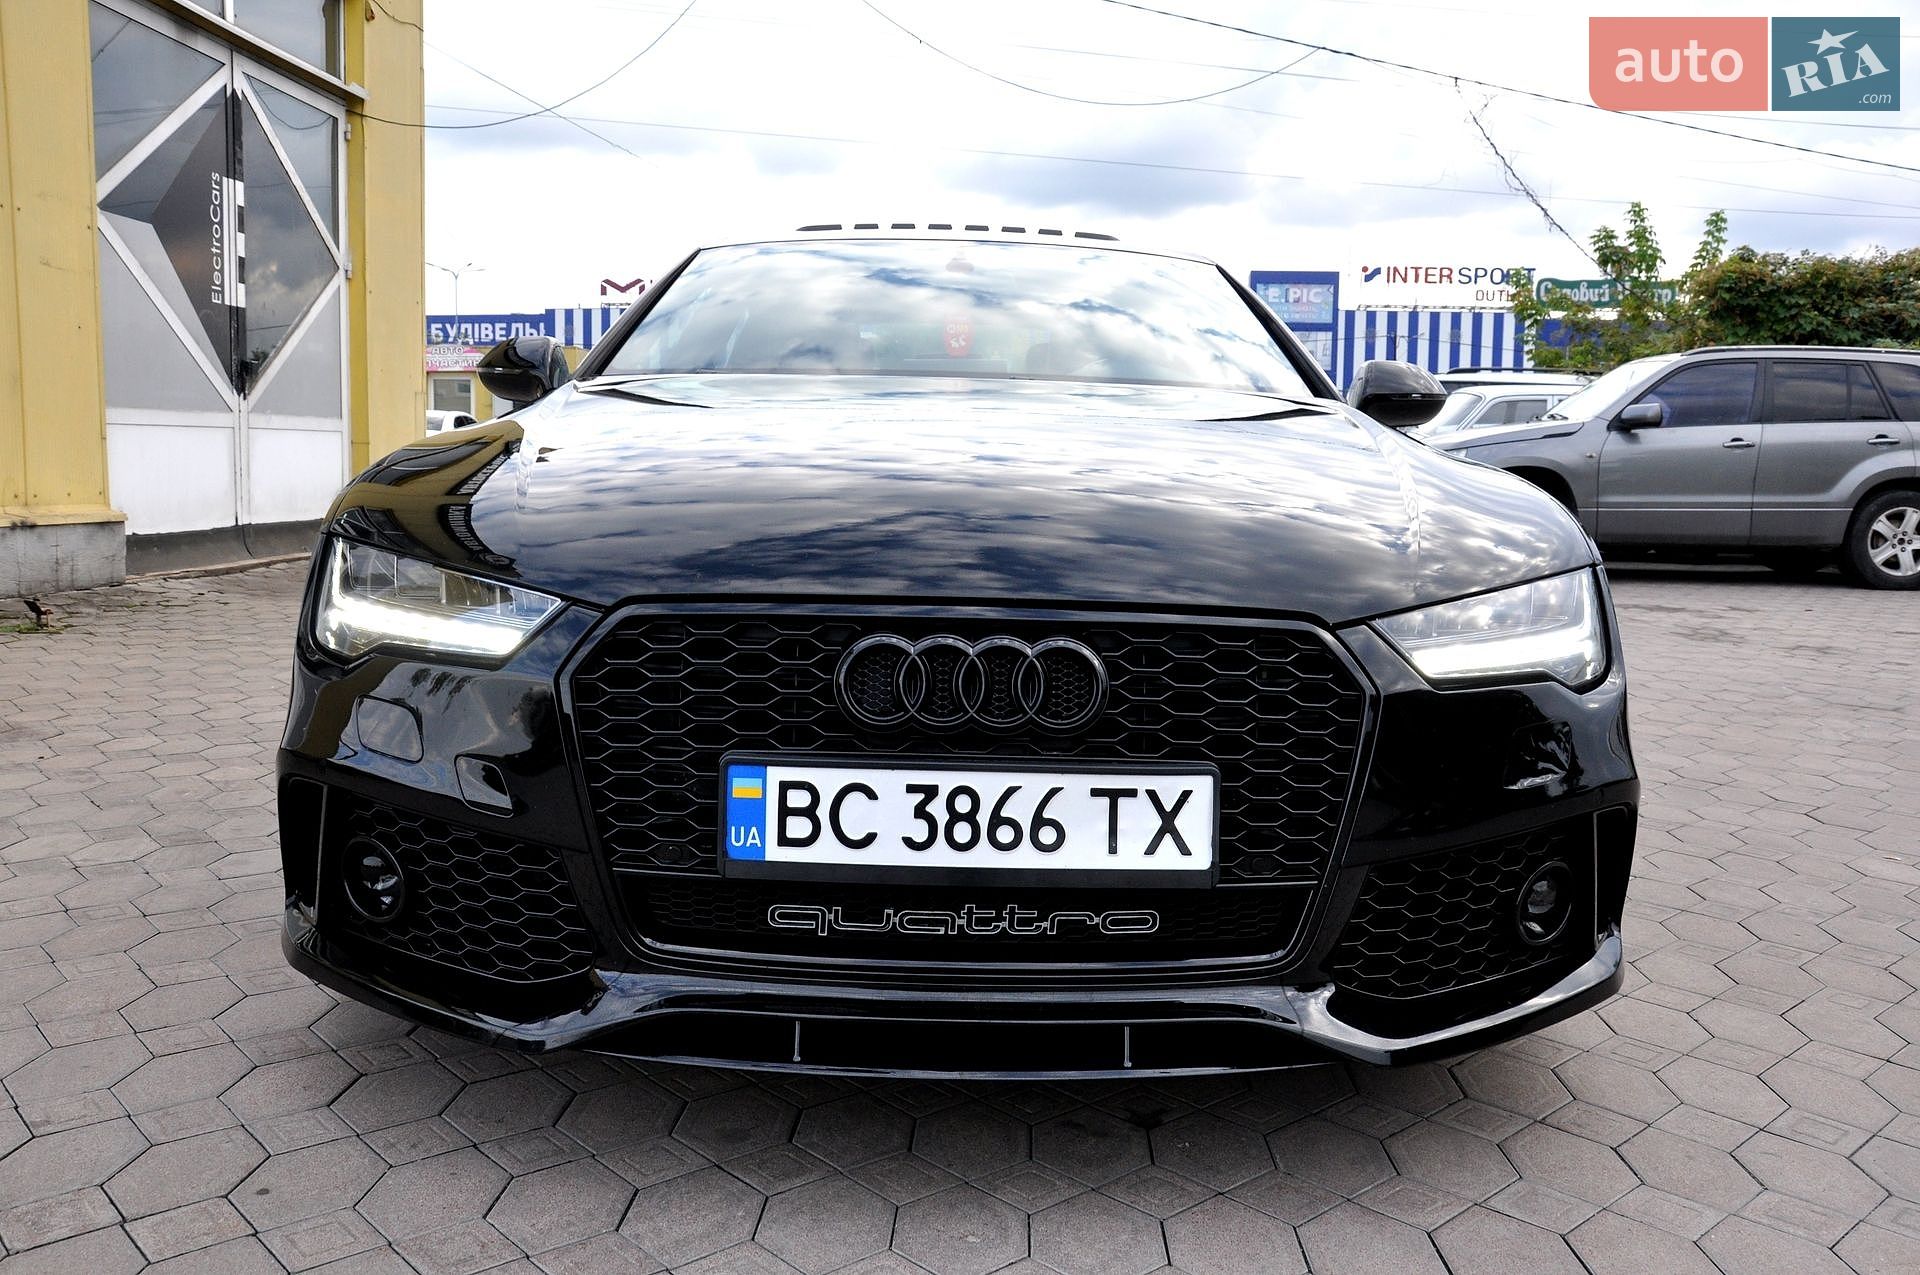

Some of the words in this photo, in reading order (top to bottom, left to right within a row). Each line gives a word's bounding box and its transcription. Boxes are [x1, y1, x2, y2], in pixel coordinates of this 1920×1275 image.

[210, 171, 223, 305] ElectroCars
[731, 825, 763, 847] UA
[776, 779, 880, 850] BC
[901, 783, 1066, 853] 3866
[1090, 786, 1194, 857] TX
[767, 903, 1160, 936] quattro
